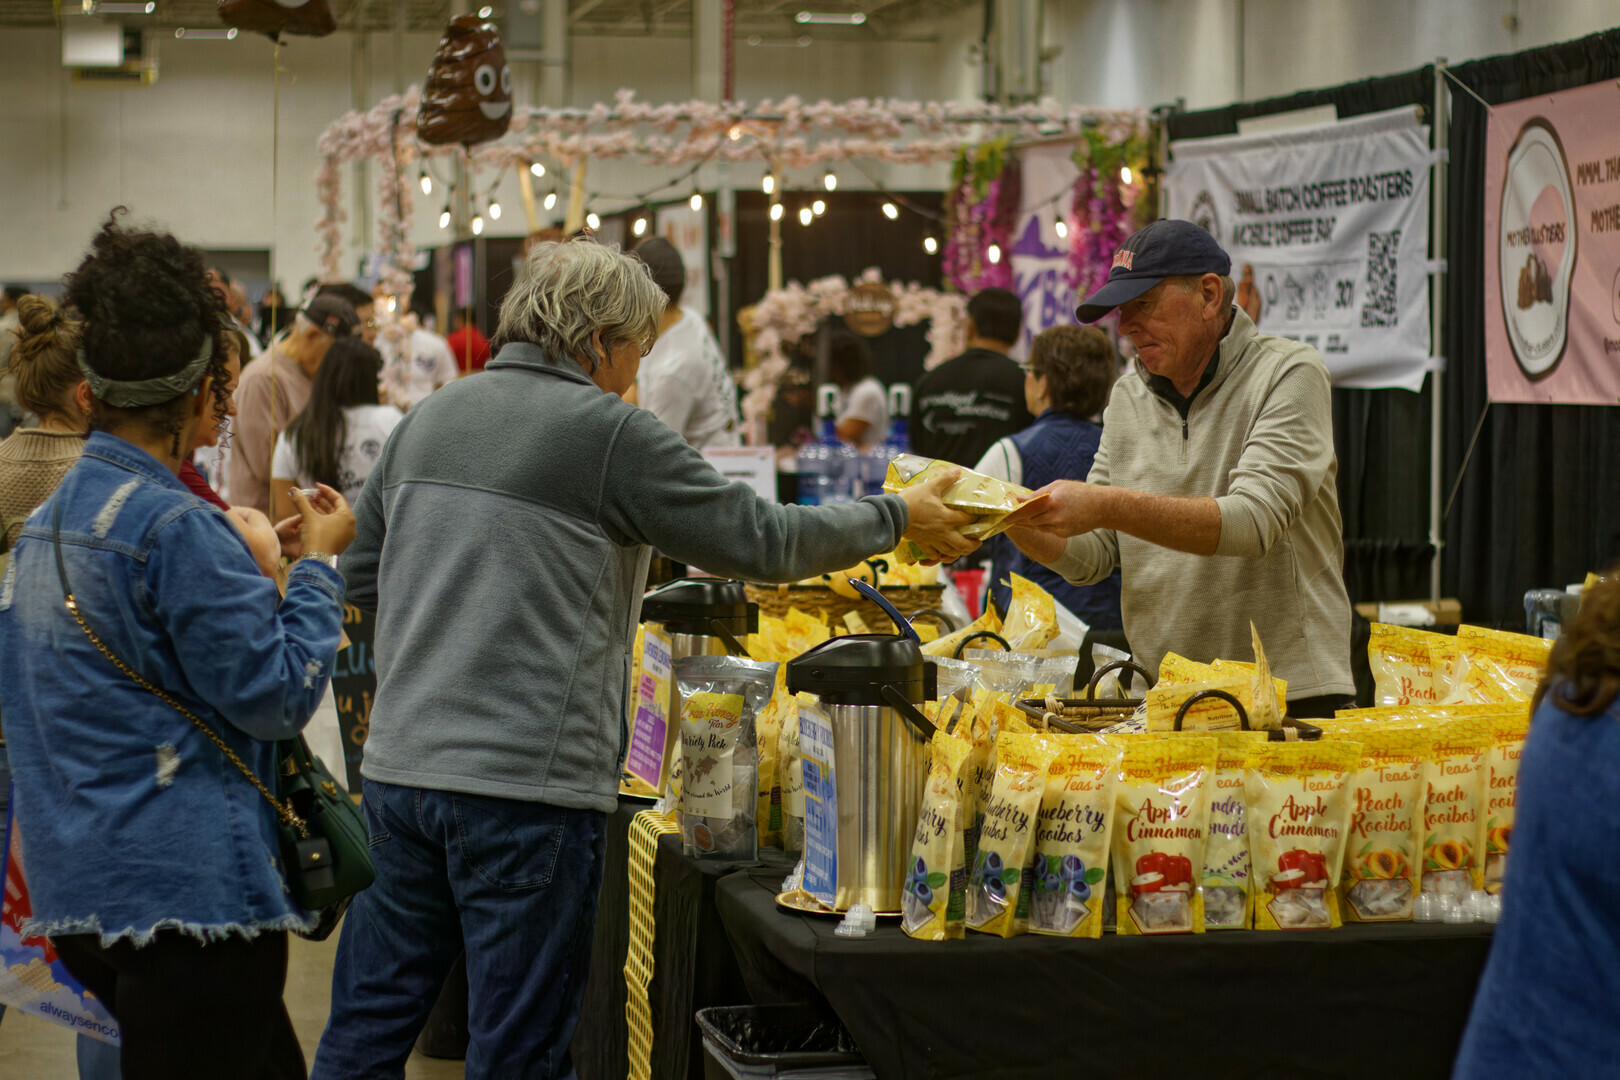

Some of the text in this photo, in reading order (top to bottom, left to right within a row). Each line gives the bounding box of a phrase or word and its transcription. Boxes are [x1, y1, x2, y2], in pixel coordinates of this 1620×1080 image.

[1302, 179, 1347, 209] COFFEE
[1349, 168, 1413, 203] ROASTERS
[1591, 203, 1620, 233] MOTHE
[1274, 218, 1313, 245] COFFEE
[1410, 650, 1431, 666] Hon
[1411, 664, 1433, 677] Tea
[1401, 676, 1437, 700] Peach
[681, 699, 739, 729] True Honey
[681, 730, 728, 752] Variety Pack
[1432, 741, 1483, 763] Honey
[1498, 745, 1522, 760] Tea
[1067, 754, 1109, 780] Honey
[1258, 755, 1345, 779] True Honey
[1373, 749, 1422, 770] Honey
[1438, 759, 1474, 777] Teas
[1063, 774, 1093, 791] Teas
[1216, 777, 1244, 788] eas
[1297, 774, 1335, 792] Teas
[1377, 766, 1413, 783] Teas
[714, 784, 731, 796] World
[1356, 787, 1405, 812] Peach
[987, 795, 1029, 833] lueberry
[1038, 797, 1105, 833] lueberry
[1137, 797, 1192, 824] Apple
[1211, 796, 1243, 815] nder
[1280, 795, 1328, 821] Apple
[1127, 817, 1201, 842] Cinnamon
[1208, 817, 1247, 836] nade
[1269, 814, 1338, 840] Cinnamon
[1351, 812, 1411, 839] Rooibos
[40, 1000, 120, 1042] alwaysenco
